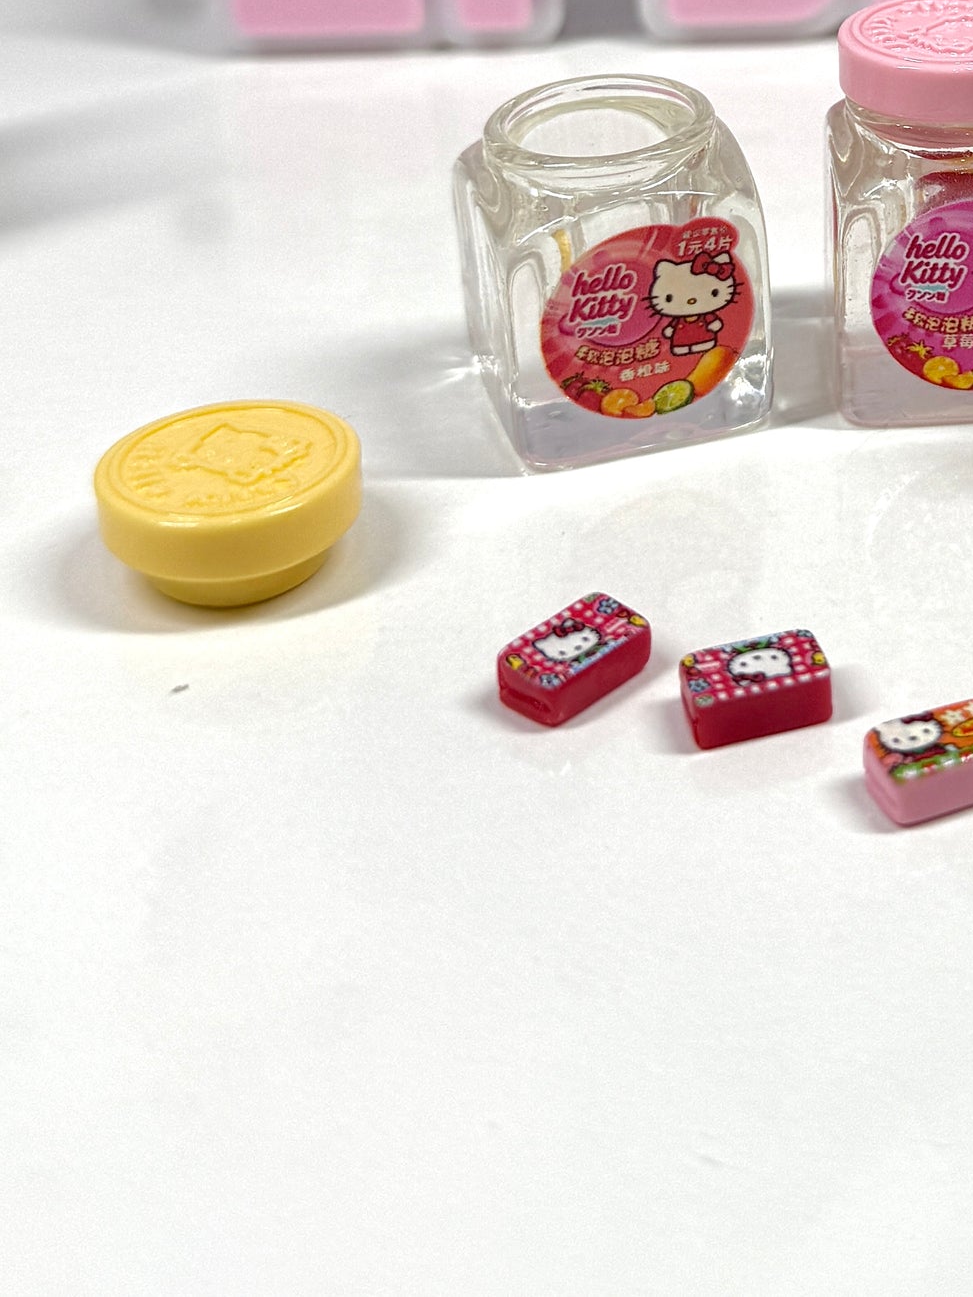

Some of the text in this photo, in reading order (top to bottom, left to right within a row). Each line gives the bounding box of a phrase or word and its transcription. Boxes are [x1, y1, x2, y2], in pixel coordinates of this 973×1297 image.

[678, 235, 733, 257] 1元4片
[905, 233, 968, 260] hello
[570, 264, 637, 298] hello
[900, 260, 967, 290] Kitty
[567, 293, 637, 323] Kitty
